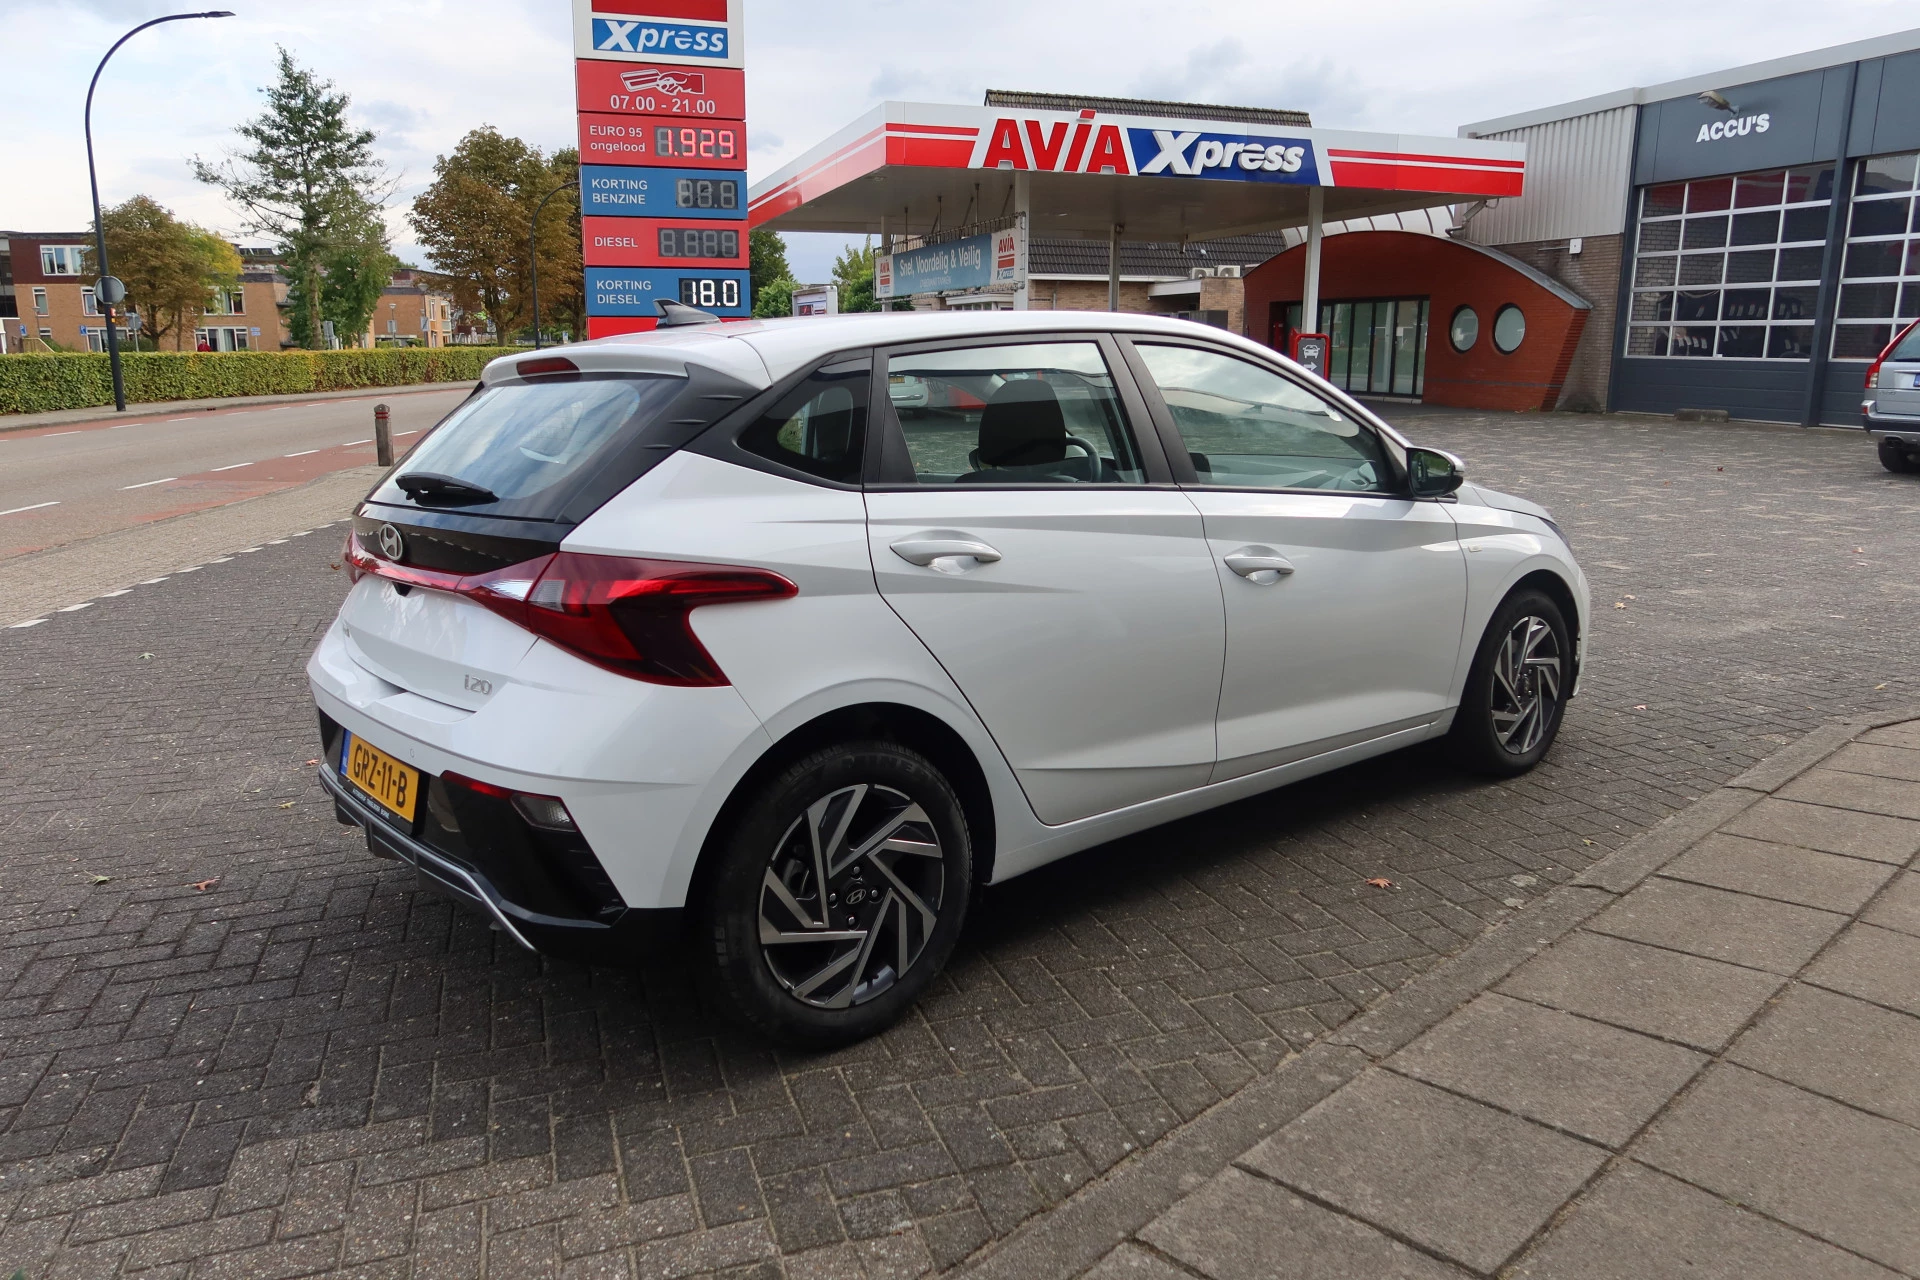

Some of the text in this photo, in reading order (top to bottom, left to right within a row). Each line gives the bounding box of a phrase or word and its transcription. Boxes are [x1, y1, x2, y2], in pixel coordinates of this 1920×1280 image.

[597, 19, 724, 53] Xpress
[610, 94, 655, 112] 07.00
[671, 97, 715, 115] 21.00
[589, 125, 643, 138] EURO 95
[1696, 113, 1770, 143] ACCU'S
[590, 141, 646, 154] ongelood
[667, 128, 735, 159] 1.929
[983, 109, 1130, 176] AVIA
[1139, 130, 1305, 176] Xpress
[591, 178, 648, 190] KORTING
[592, 193, 646, 205] BENZINE
[594, 236, 638, 248] DIESEL
[998, 234, 1015, 253] AVIA
[900, 244, 981, 278] Snel, Voordelig & Veilig
[596, 279, 652, 291] KORTING
[692, 279, 738, 307] 18.0
[597, 294, 640, 305] DIESEL
[464, 674, 493, 695] i20
[353, 743, 408, 809] GRZ-11-B
